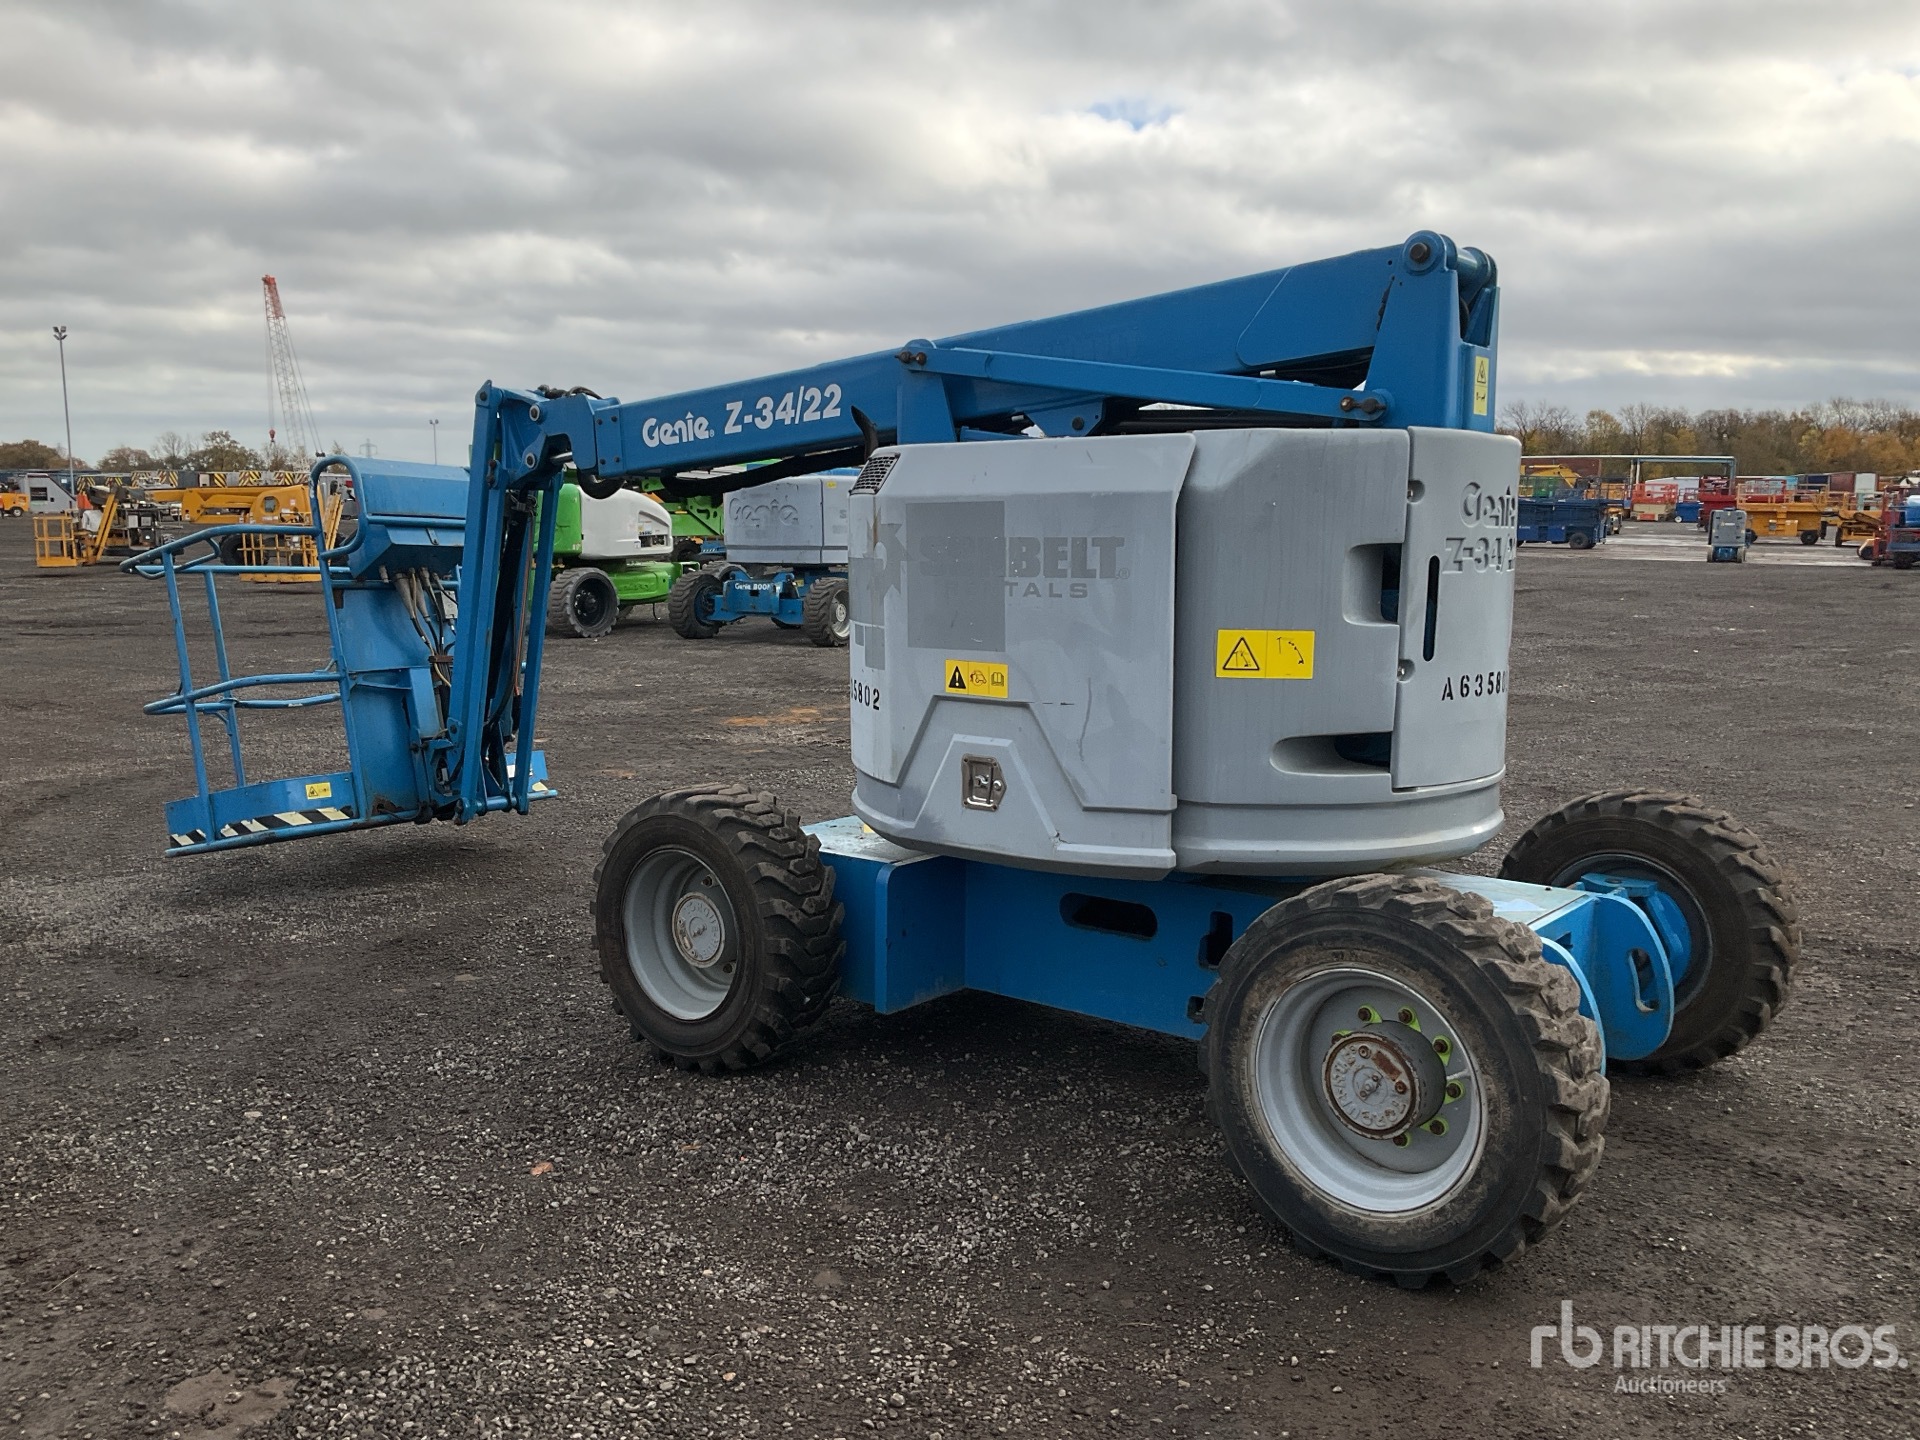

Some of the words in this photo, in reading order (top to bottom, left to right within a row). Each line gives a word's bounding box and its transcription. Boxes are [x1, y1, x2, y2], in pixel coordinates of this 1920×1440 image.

[642, 411, 710, 447] Genie
[724, 383, 842, 435] Z-34/22
[850, 678, 880, 711] 5802
